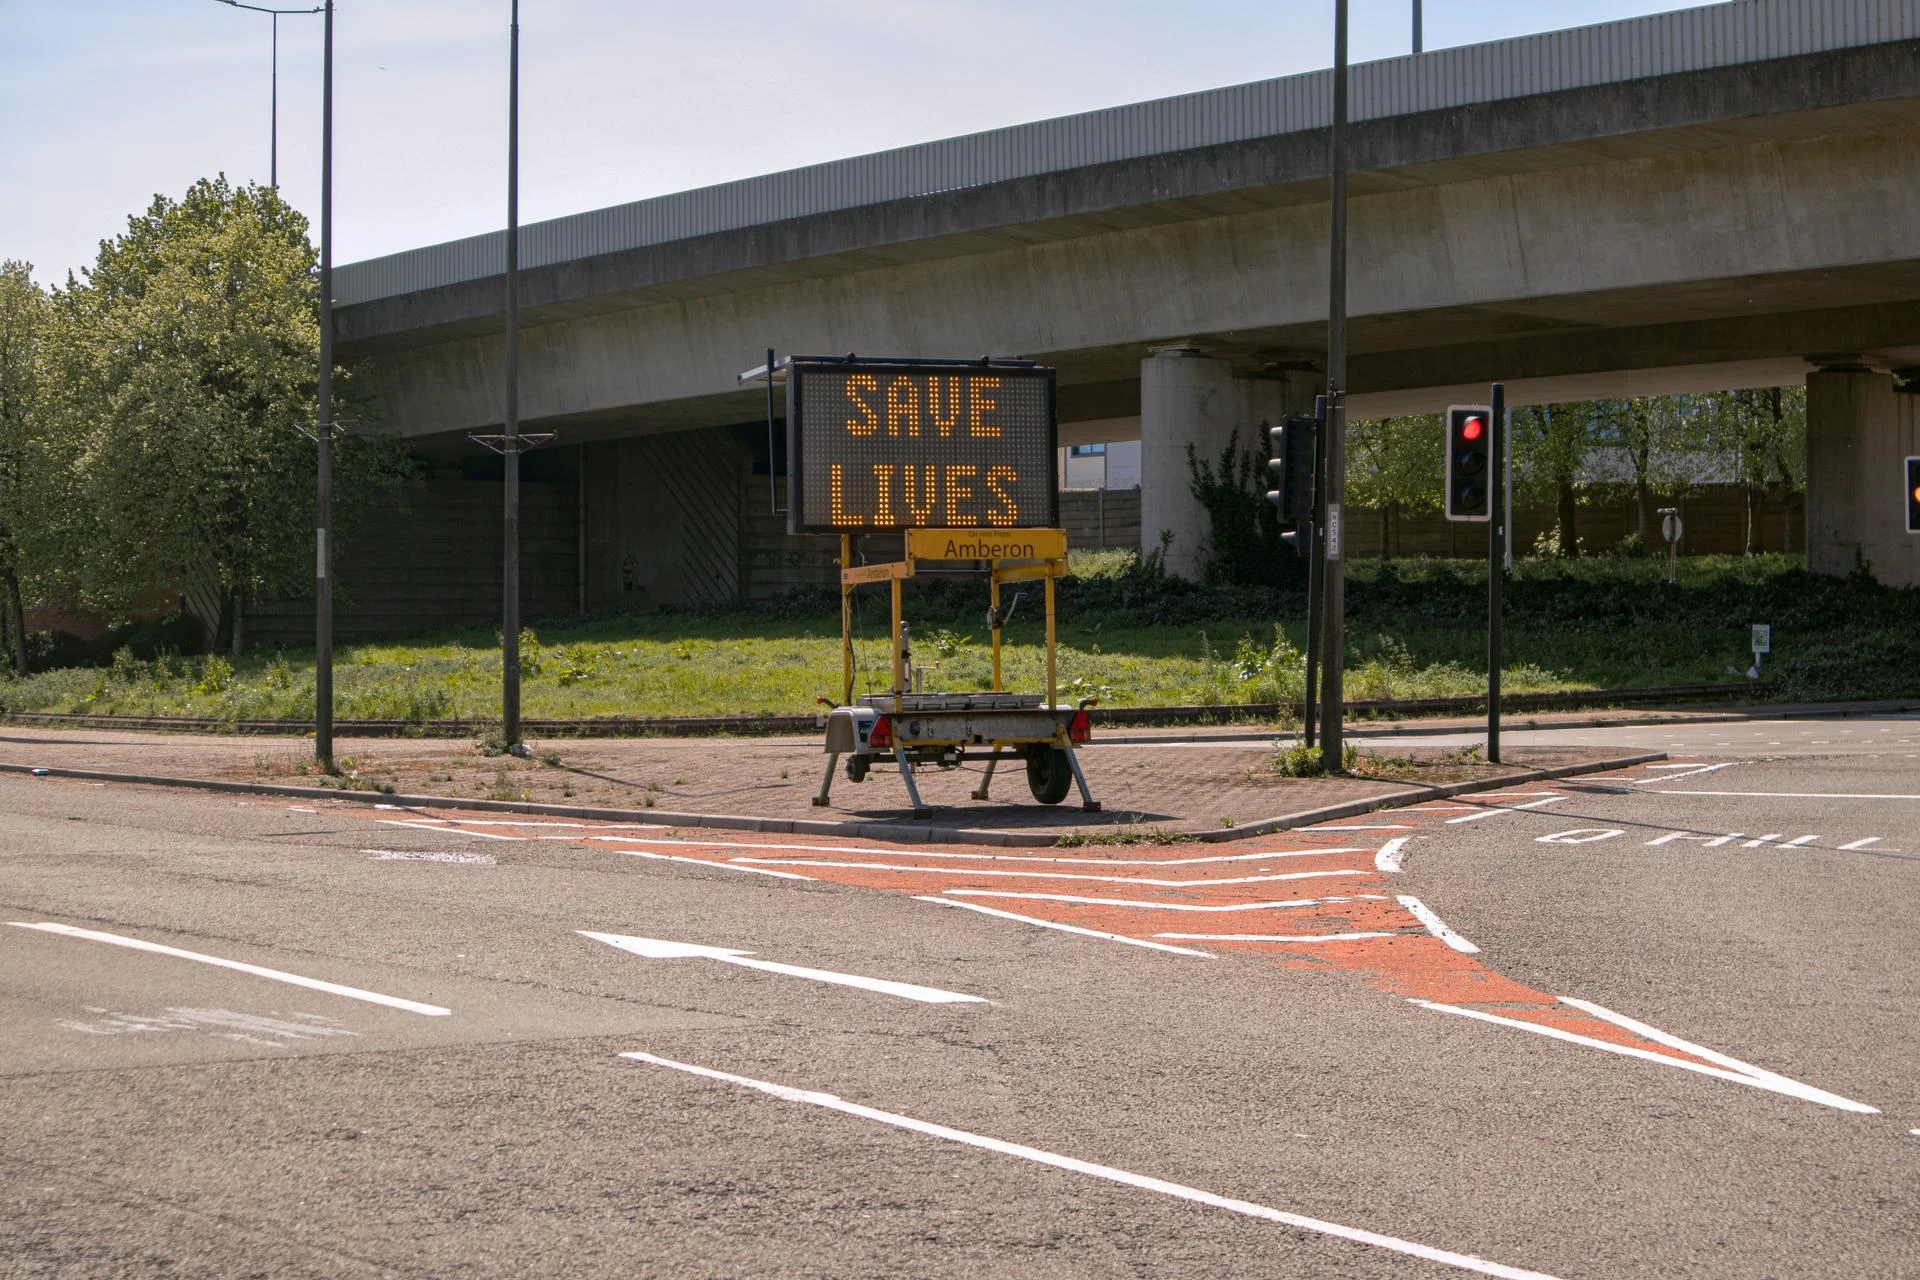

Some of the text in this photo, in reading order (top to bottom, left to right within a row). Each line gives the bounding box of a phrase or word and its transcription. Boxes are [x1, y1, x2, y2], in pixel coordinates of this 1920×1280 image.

[846, 374, 1001, 437] SAVE
[831, 464, 1017, 525] LIVES
[944, 539, 1034, 558] Amberon
